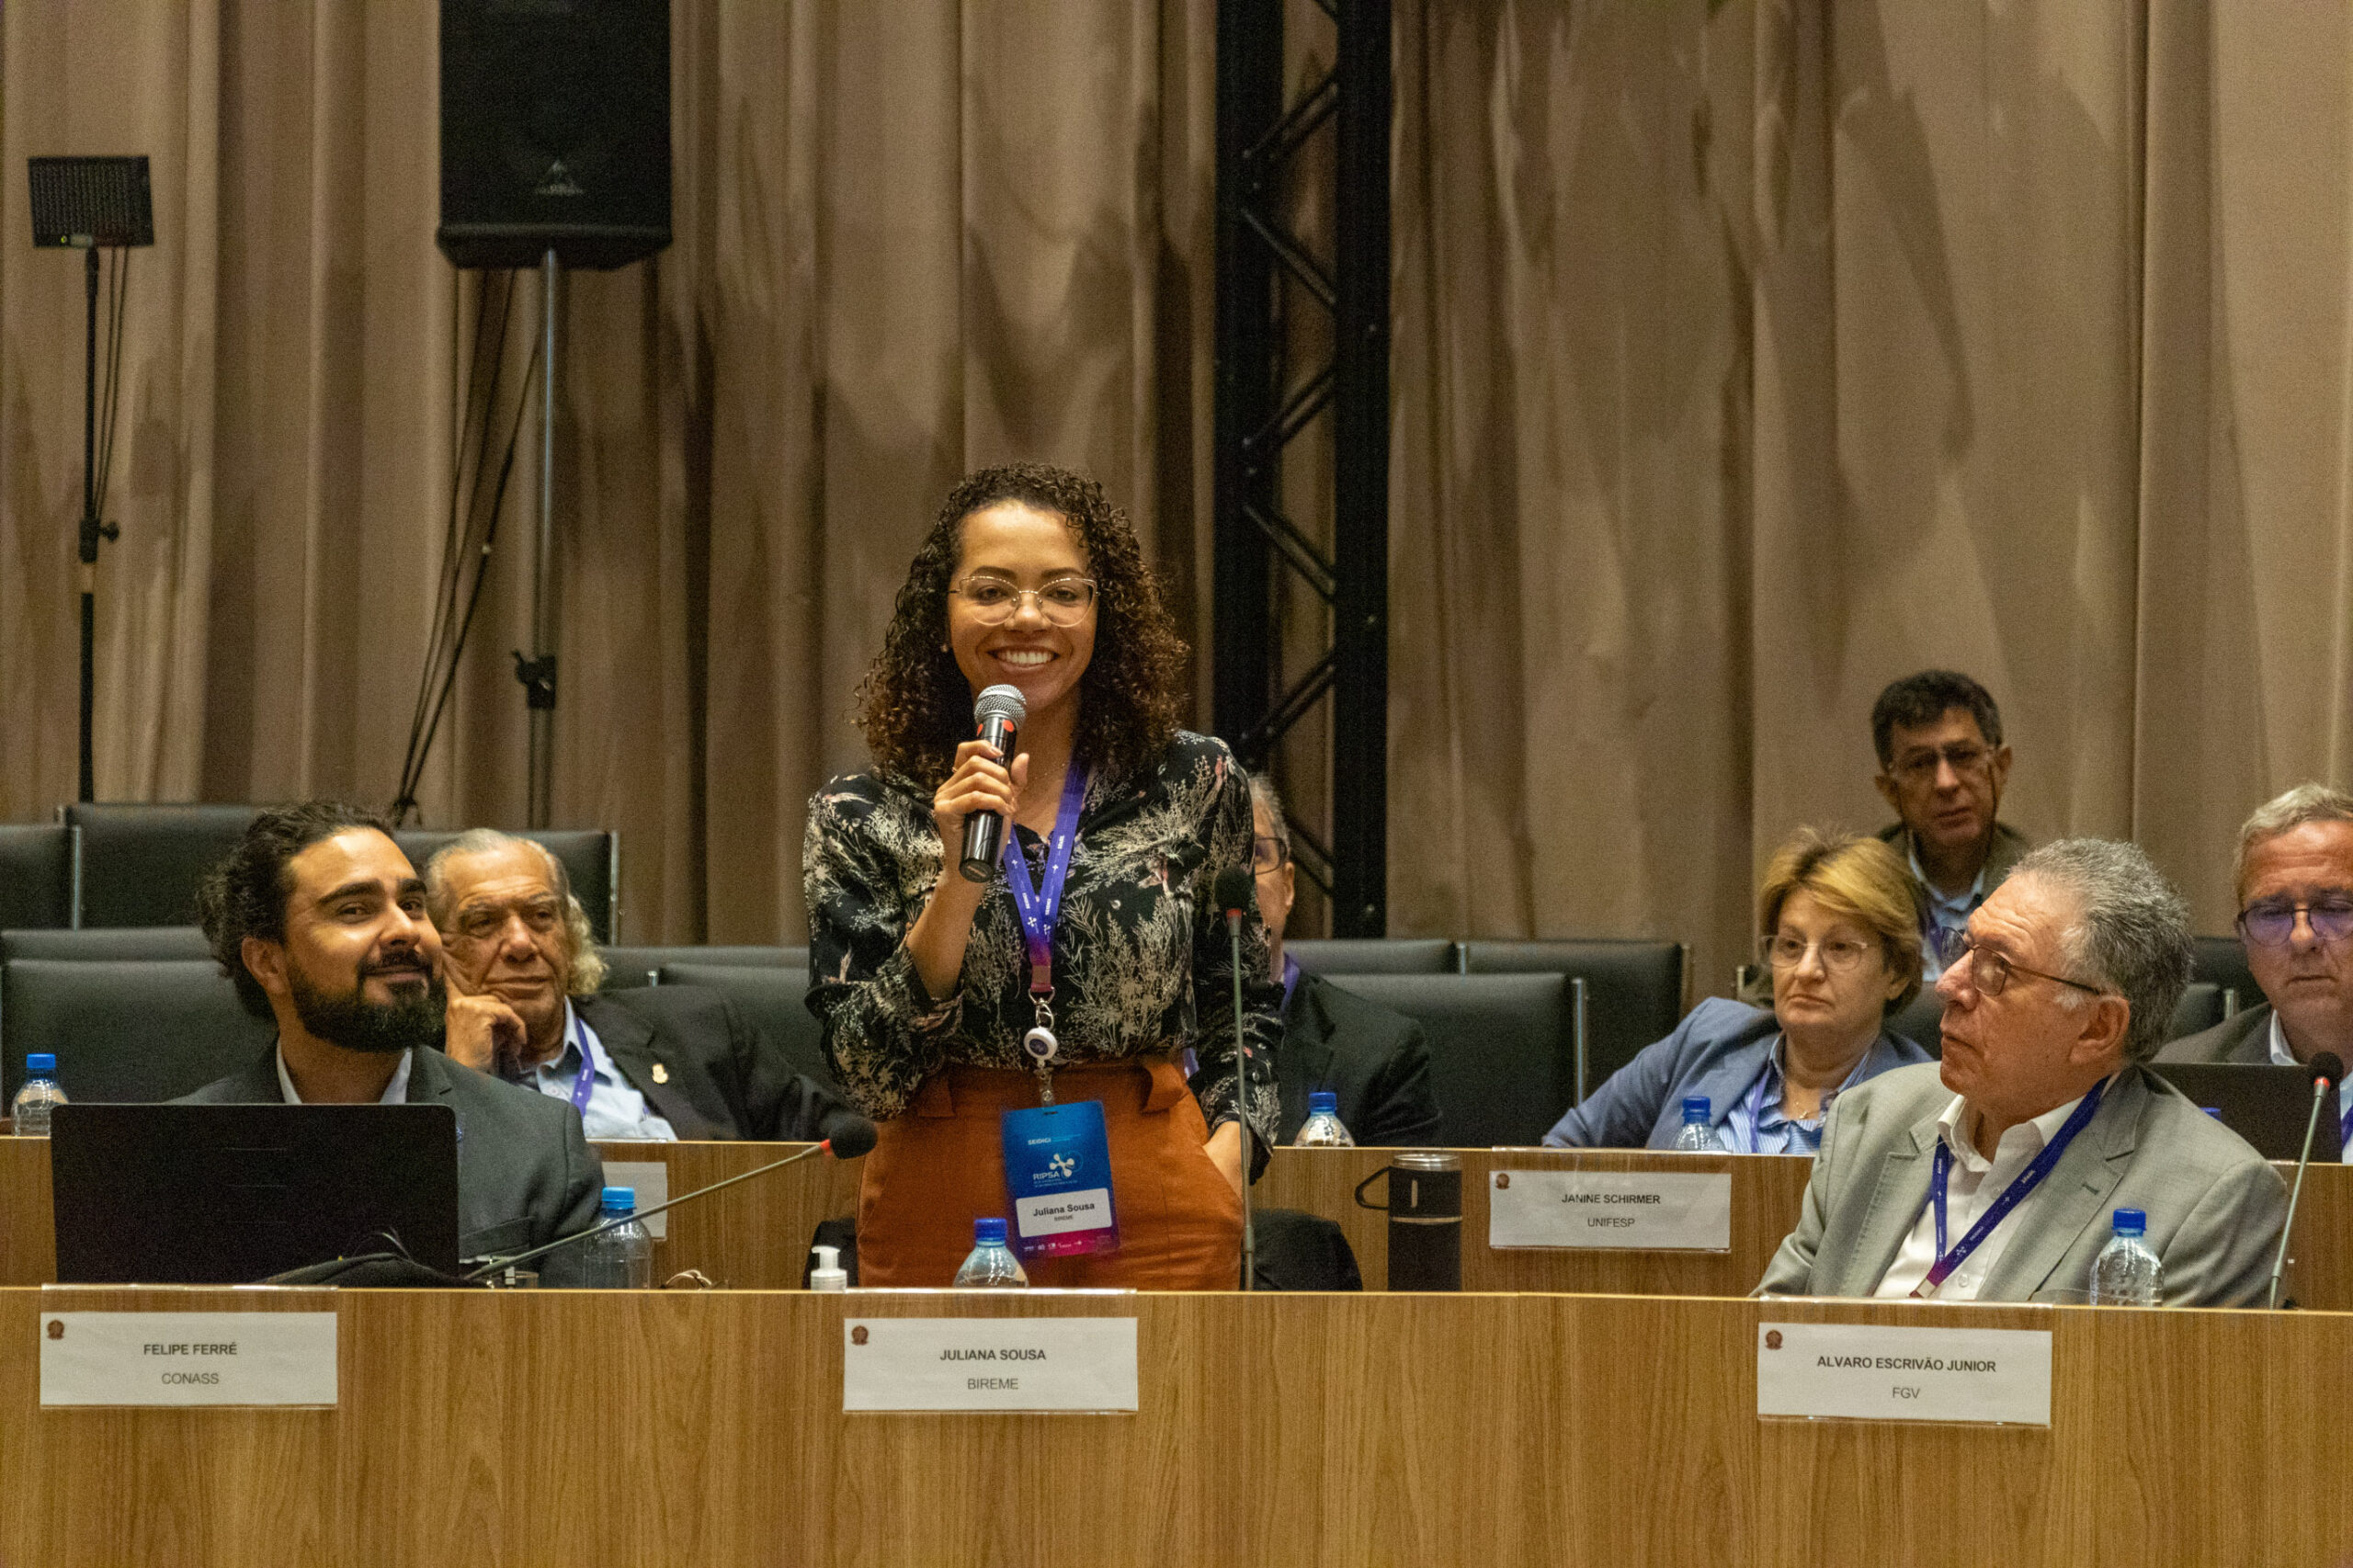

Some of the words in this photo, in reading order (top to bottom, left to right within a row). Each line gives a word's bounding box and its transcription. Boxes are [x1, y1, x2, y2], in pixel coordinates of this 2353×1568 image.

[1032, 1171, 1061, 1181] RIPSA
[1562, 1194, 1601, 1204] JANINE
[1603, 1194, 1661, 1204] SCHIRMER
[1033, 1206, 1065, 1217] Juliana
[1067, 1202, 1096, 1213] Sousa
[1587, 1218, 1635, 1228] UNIFESP
[143, 1344, 189, 1355] FELIPE
[192, 1342, 237, 1355] FERRÉ
[939, 1349, 996, 1360] JULIANA
[999, 1349, 1047, 1360] SOUSA
[1817, 1356, 1872, 1369] ALVARO
[1875, 1357, 1944, 1371] ESCRIVÃO
[1947, 1359, 1996, 1372] JUNIOR
[161, 1372, 220, 1385] CONASS
[967, 1378, 1018, 1390] BIREME
[1892, 1386, 1921, 1399] FGV
